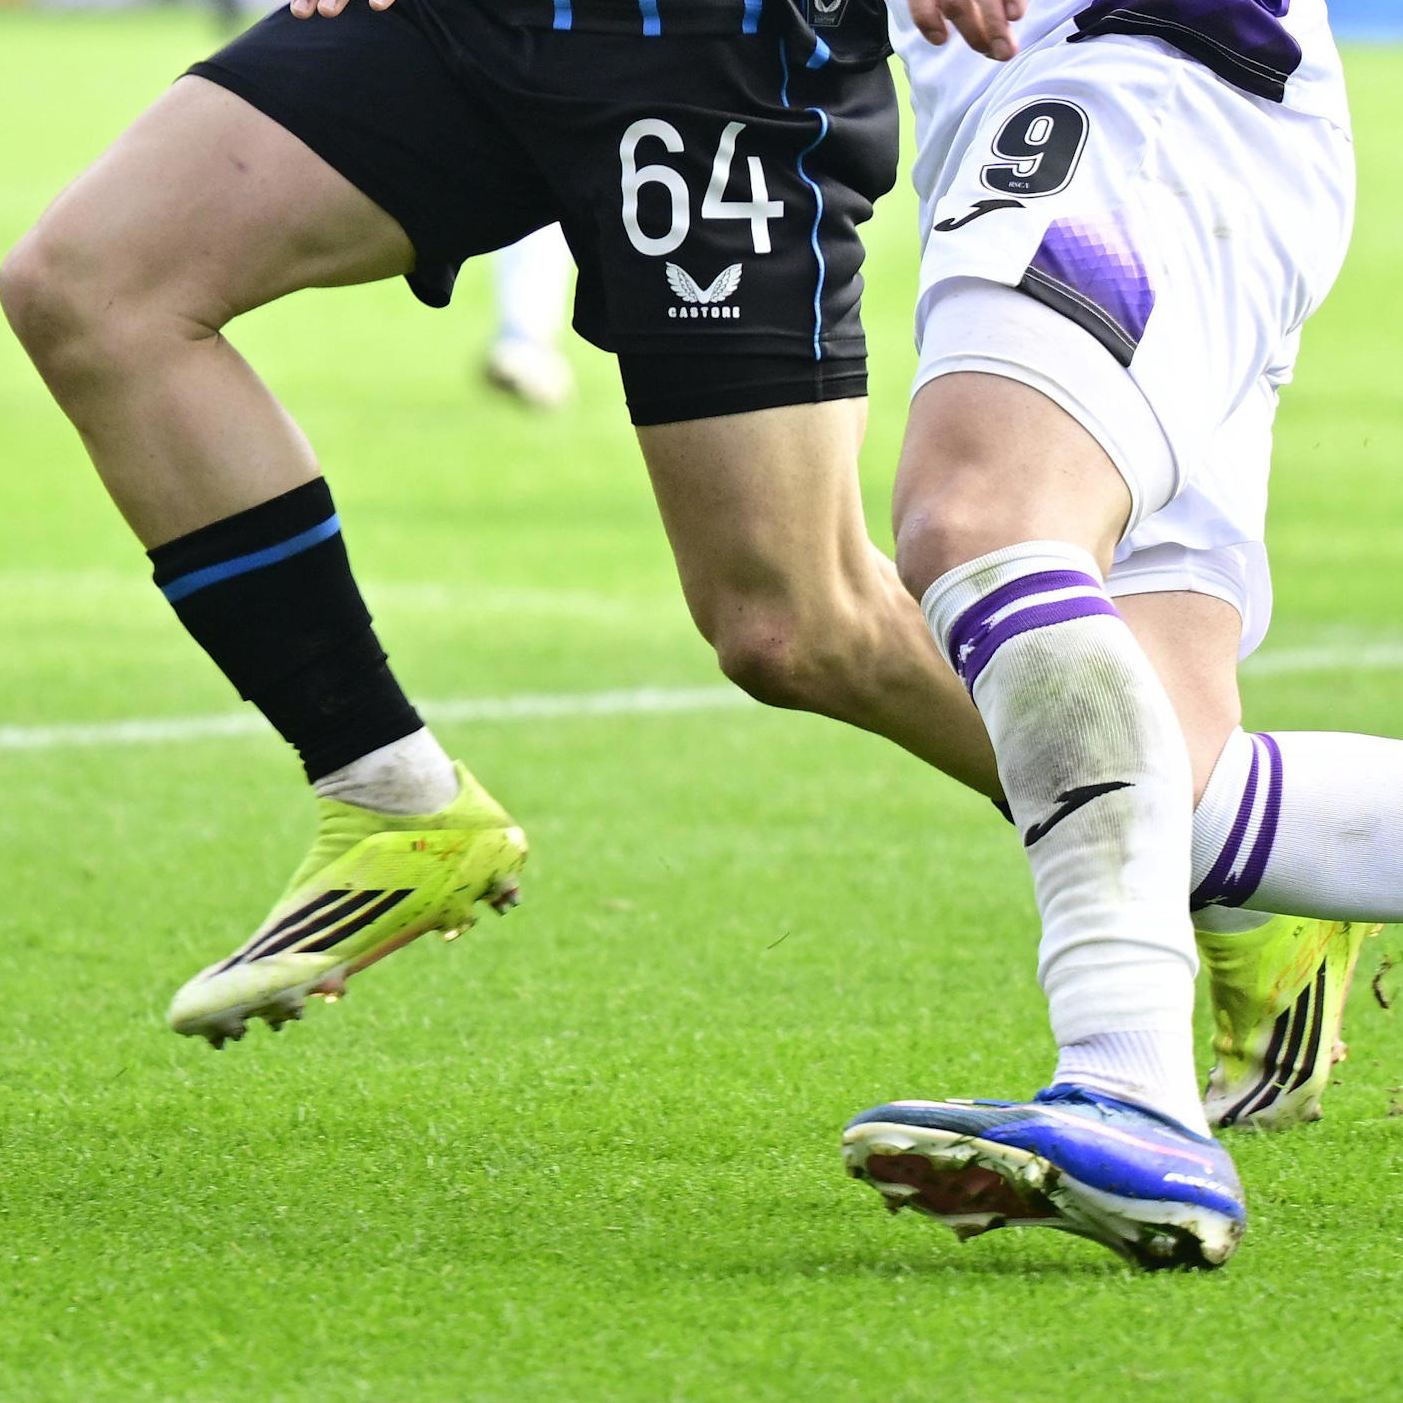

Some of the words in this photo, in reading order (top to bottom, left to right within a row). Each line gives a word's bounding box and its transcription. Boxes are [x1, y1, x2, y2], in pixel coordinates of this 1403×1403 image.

[619, 118, 784, 257] 64
[979, 99, 1090, 197] 9
[668, 306, 740, 318] CASTORE
